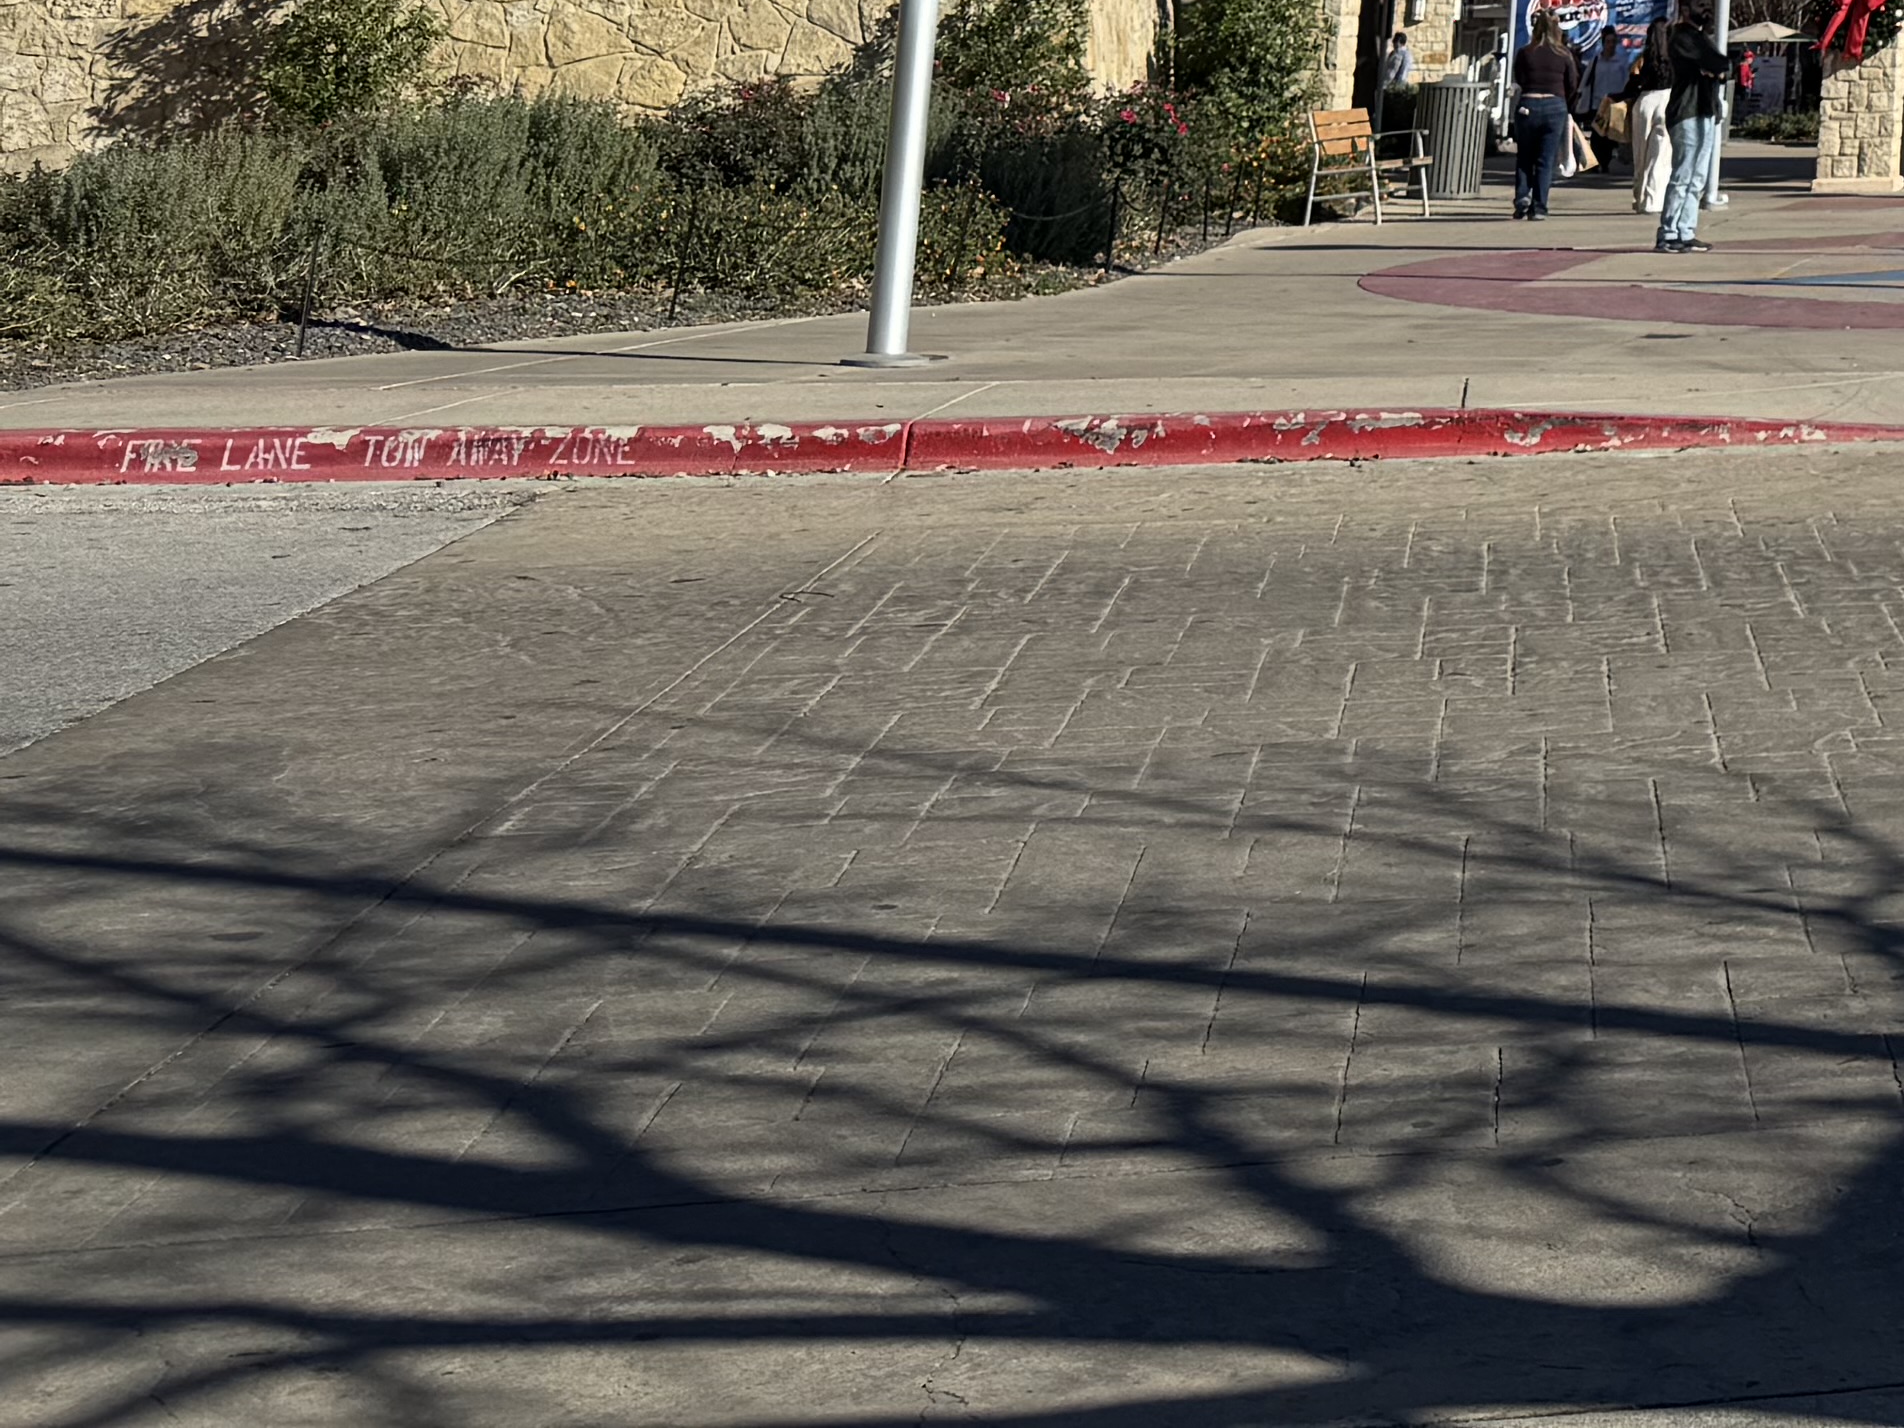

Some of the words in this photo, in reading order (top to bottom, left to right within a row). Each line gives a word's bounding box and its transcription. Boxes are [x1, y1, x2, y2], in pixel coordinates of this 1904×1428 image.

[120, 438, 202, 473] FIRE
[219, 437, 312, 472] LANE
[361, 435, 425, 468] TOW
[447, 435, 526, 468] AWAY
[550, 434, 636, 467] ZONE
